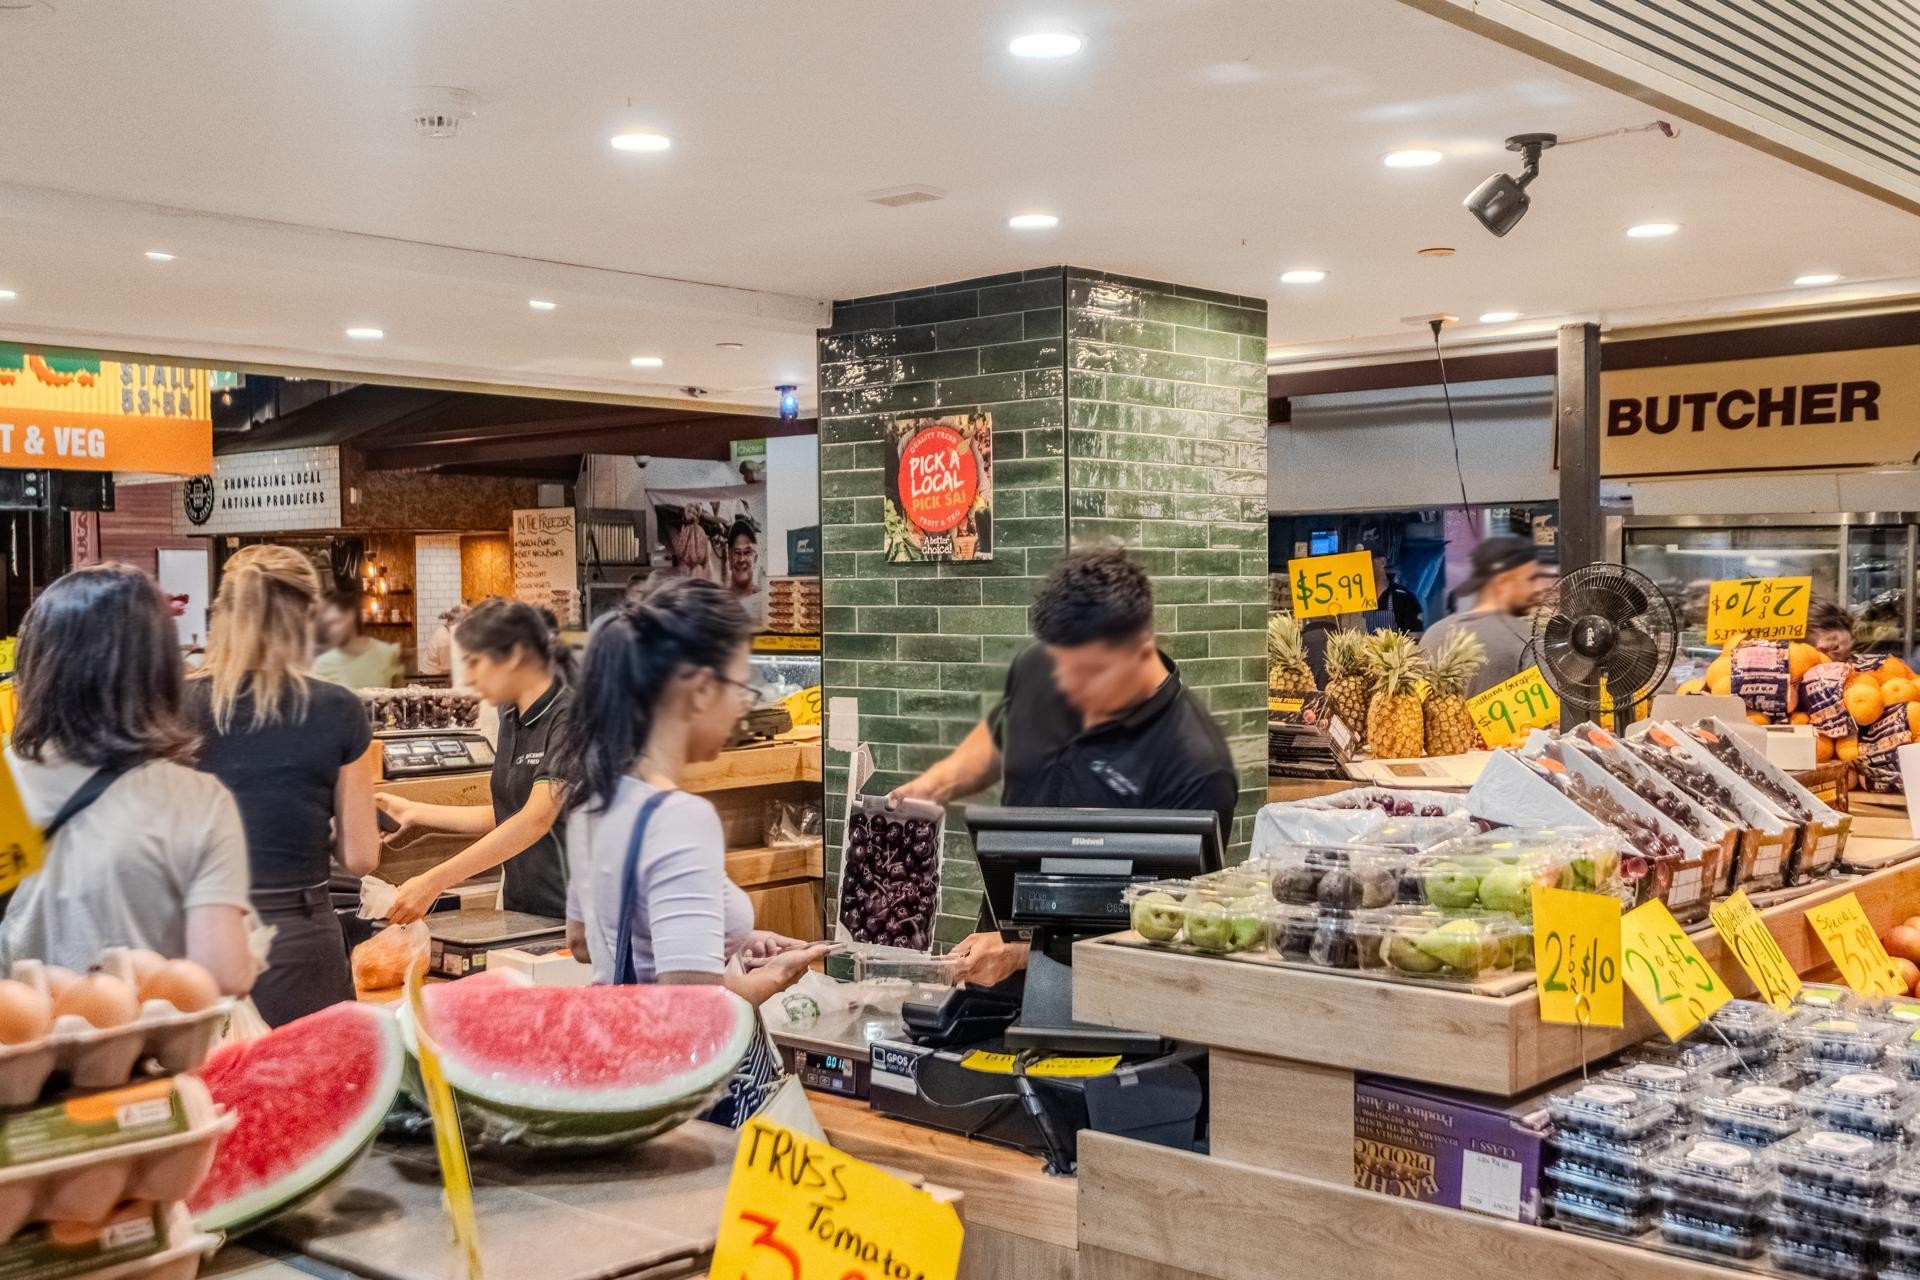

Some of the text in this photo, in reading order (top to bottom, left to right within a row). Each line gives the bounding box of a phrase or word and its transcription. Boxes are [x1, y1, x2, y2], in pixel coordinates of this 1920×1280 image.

[1607, 380, 1881, 437] BUTCHER
[24, 425, 44, 455] &
[54, 427, 105, 457] VEG
[910, 431, 957, 454] QUALITY FRESH
[909, 449, 960, 478] PICK A
[224, 469, 321, 491] SHOWCASING LOCAL
[911, 470, 965, 498] LOCAL
[221, 491, 325, 510] ARTISAN PRODUCERS
[912, 494, 941, 512] PICK
[525, 514, 538, 531] THE
[539, 513, 574, 531] FREEZER
[919, 514, 940, 528] FRUIT
[921, 542, 952, 555] choice!
[930, 535, 950, 545] better
[1297, 569, 1364, 610] $5.99
[1773, 584, 1804, 617] 2
[1467, 670, 1540, 710] Sultana Grapes
[1544, 930, 1569, 992] 2
[1625, 946, 1682, 1005] 2
[887, 1052, 908, 1067] GPOS
[1355, 1094, 1454, 1129] Produce of Aust
[1386, 1122, 1414, 1136] SOUTH
[747, 1123, 848, 1202] TRUSS
[1479, 1140, 1515, 1158] CLASS
[808, 1202, 926, 1280] Tomato
